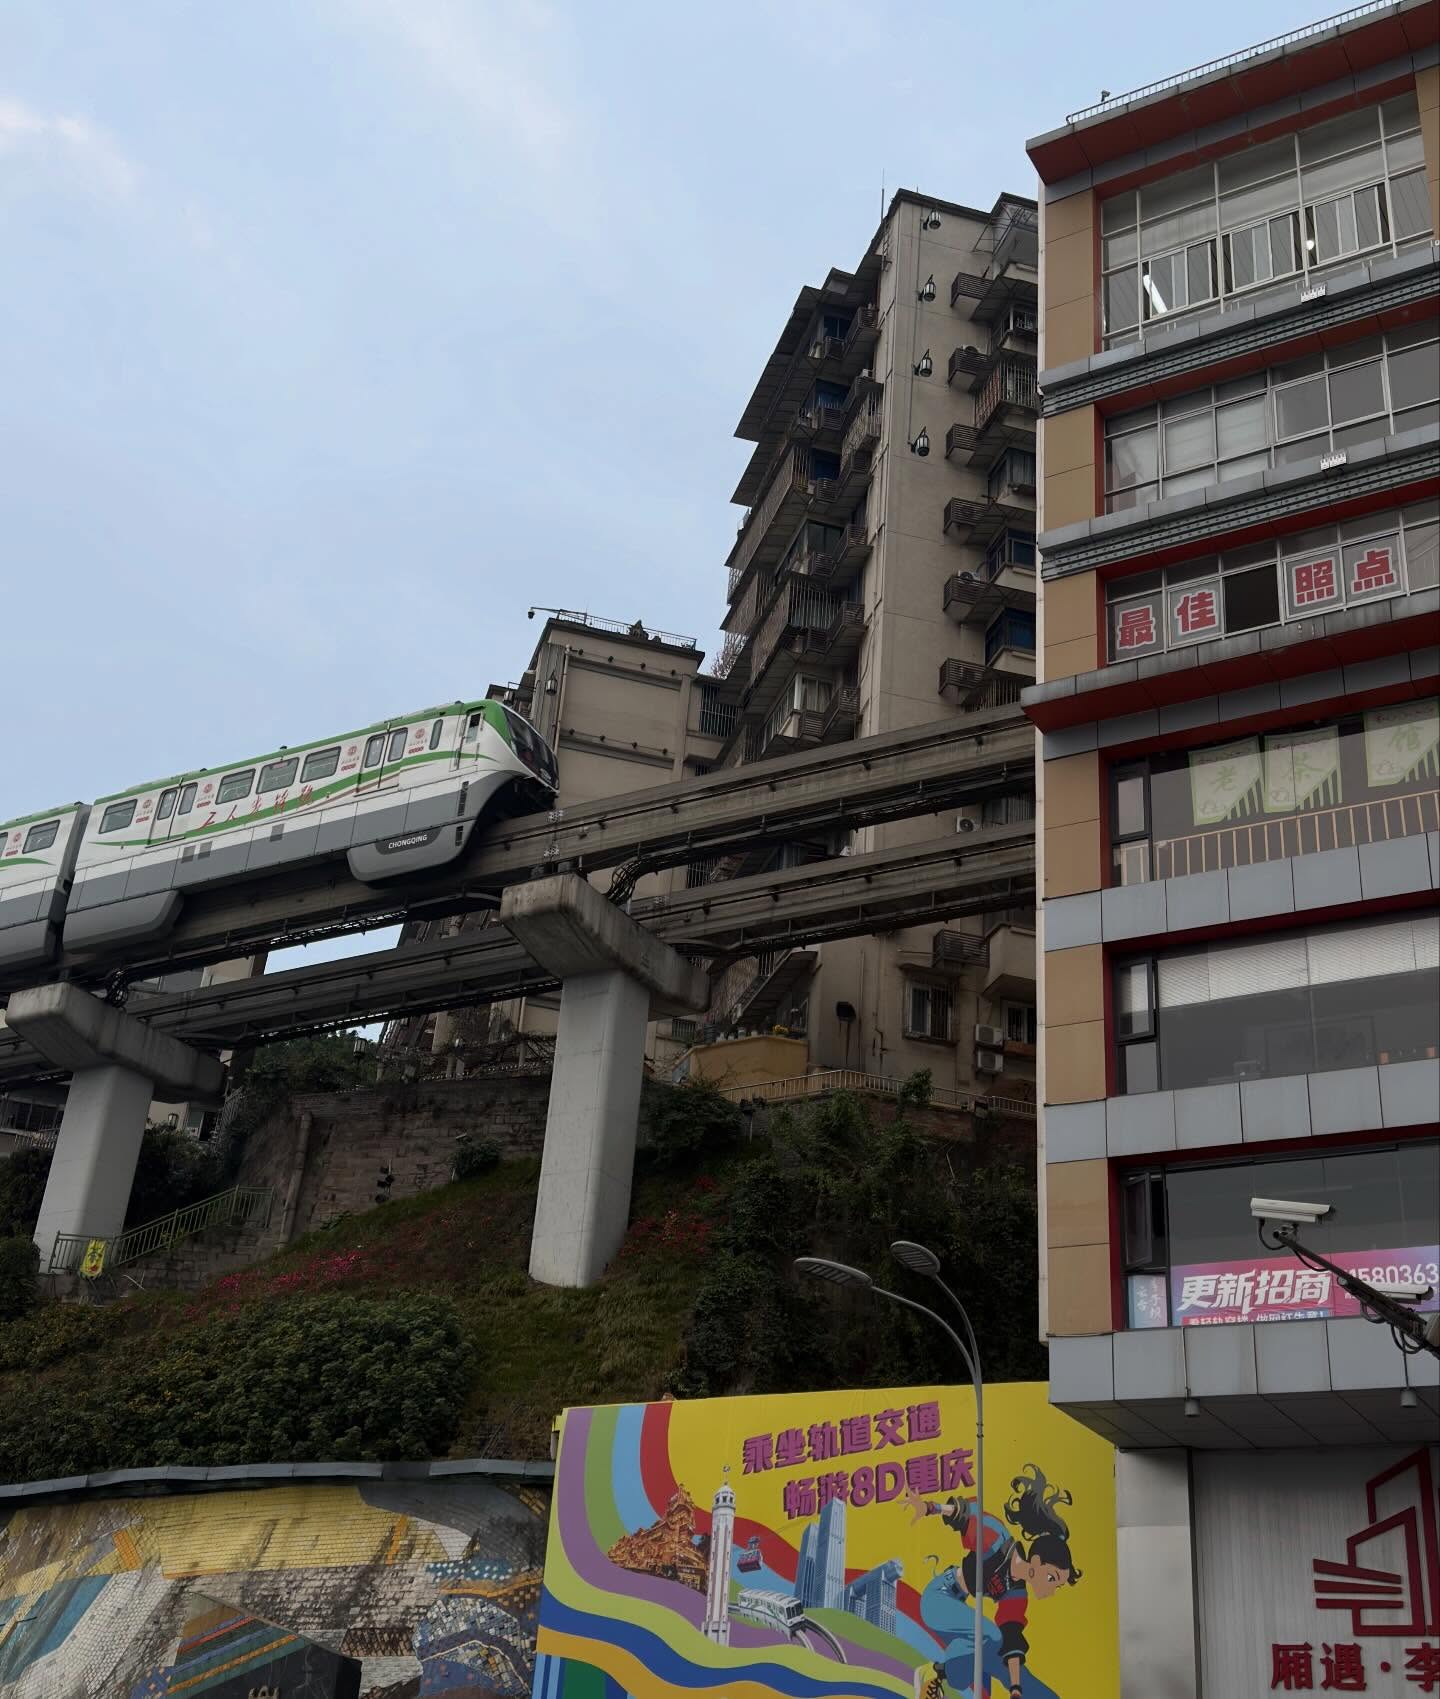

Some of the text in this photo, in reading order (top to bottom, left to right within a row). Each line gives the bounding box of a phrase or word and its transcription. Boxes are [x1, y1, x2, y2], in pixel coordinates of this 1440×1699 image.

[388, 834, 428, 849] CHONGQING
[1178, 1269, 1331, 1315] 更新招商
[742, 1400, 943, 1475] 乘坐轨道交通
[783, 1448, 976, 1520] 畅游8D重庆
